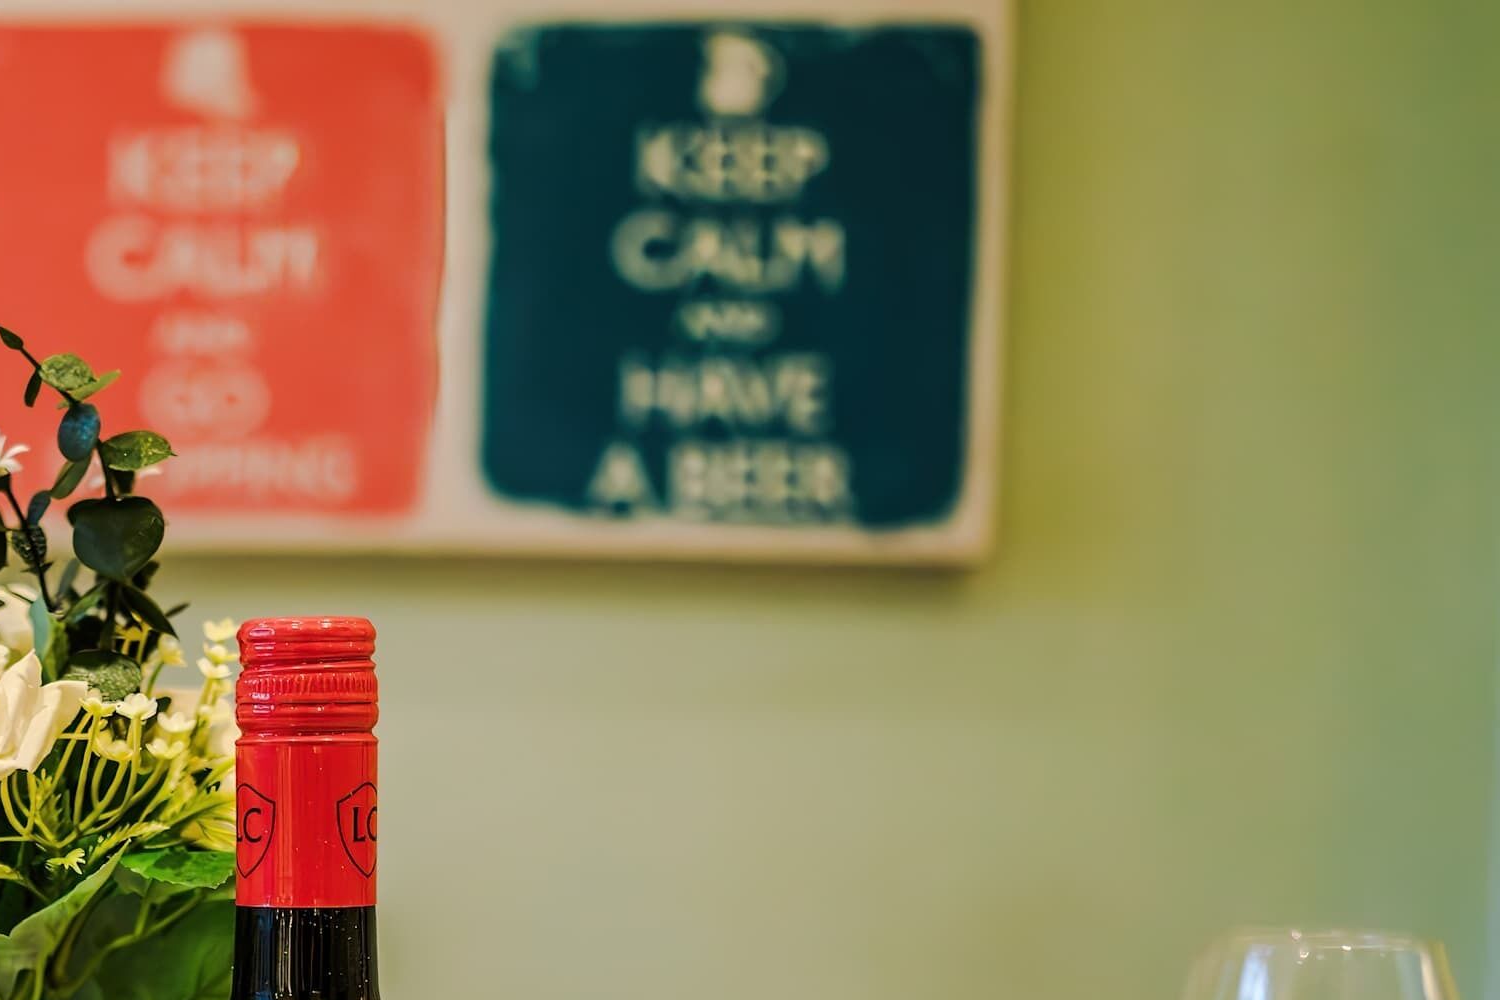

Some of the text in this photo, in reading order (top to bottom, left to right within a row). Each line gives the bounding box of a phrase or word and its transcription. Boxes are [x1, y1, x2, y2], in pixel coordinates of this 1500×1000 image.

[636, 125, 828, 200] KEEP
[610, 209, 845, 291] CALM
[619, 355, 826, 433] HAVE
[589, 440, 857, 523] A BEER
